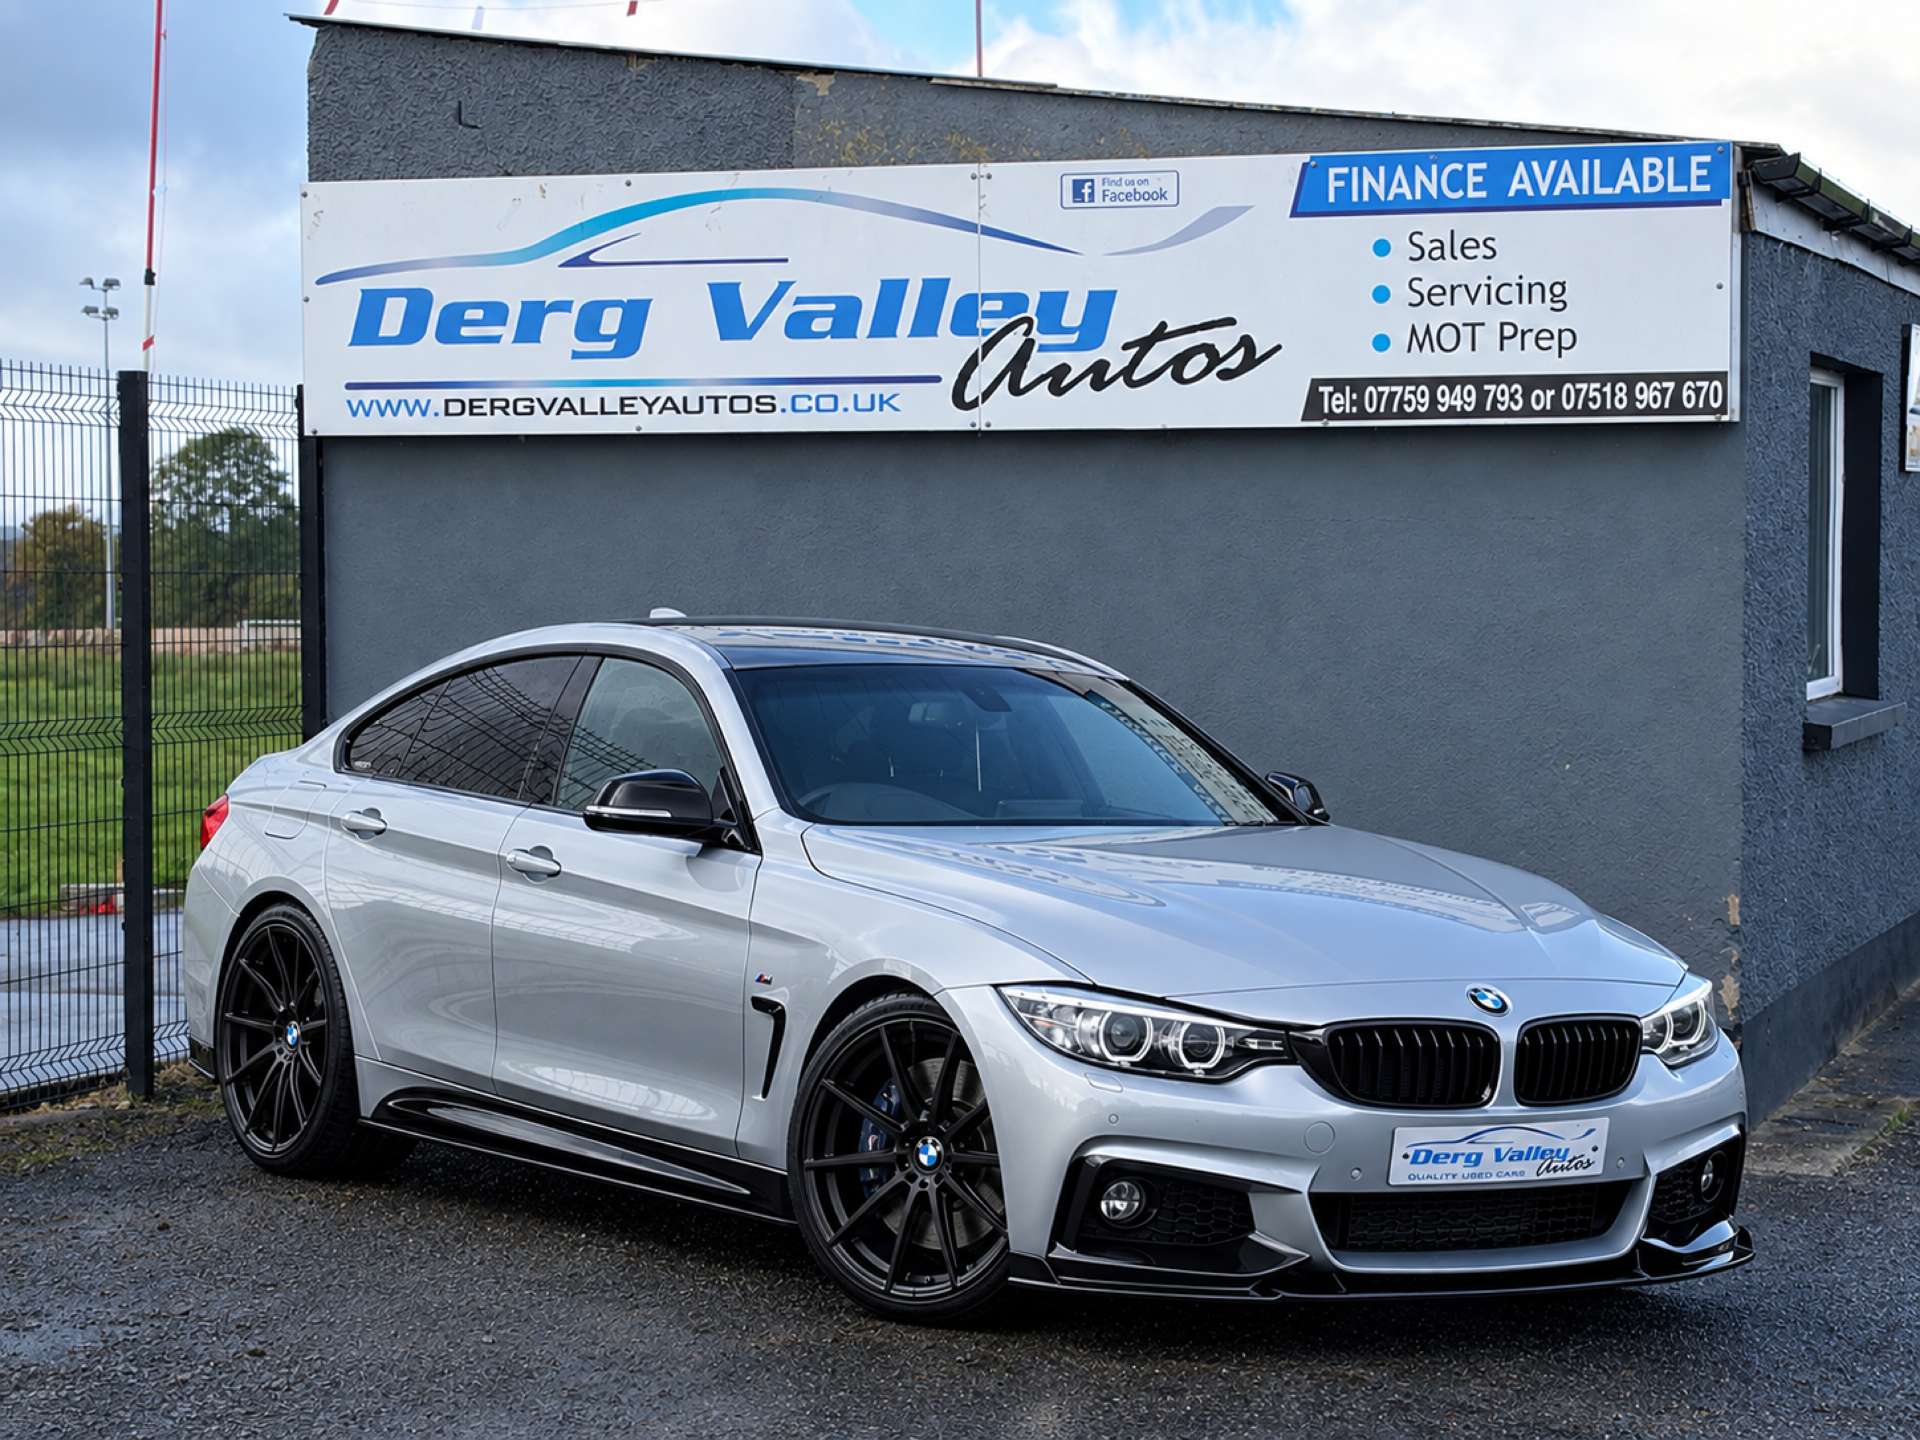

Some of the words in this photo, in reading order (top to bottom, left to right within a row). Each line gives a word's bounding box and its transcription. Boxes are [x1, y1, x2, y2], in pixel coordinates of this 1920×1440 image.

[1102, 178, 1122, 186] Find
[1138, 178, 1149, 186] on
[1102, 188, 1168, 202] Facebook
[1327, 162, 1488, 203] FINANCE
[1508, 154, 1713, 198] AVAILABLE
[1407, 229, 1498, 262] Sales
[1407, 274, 1568, 312] Servicing
[348, 287, 652, 360] Derg
[707, 277, 1118, 352] Valley
[1406, 322, 1485, 354] MOT
[1498, 322, 1577, 358] Prep
[951, 317, 1282, 411] Autos
[346, 392, 901, 417] WWW.DERGVALLEYAUTOS.CO.UK
[1319, 386, 1358, 414] Tel:
[1363, 386, 1428, 413] 07759
[1436, 385, 1477, 411] 949
[1484, 384, 1523, 411] 793
[1530, 388, 1555, 411] or
[1561, 383, 1626, 410] 07518
[1635, 382, 1675, 409] 967
[1682, 381, 1723, 409] 670
[1409, 1149, 1484, 1168] Derg
[1493, 1145, 1570, 1163] Valley
[1536, 1154, 1596, 1177] Autos
[1408, 1173, 1458, 1181] QUALITY
[1462, 1171, 1493, 1179] USED
